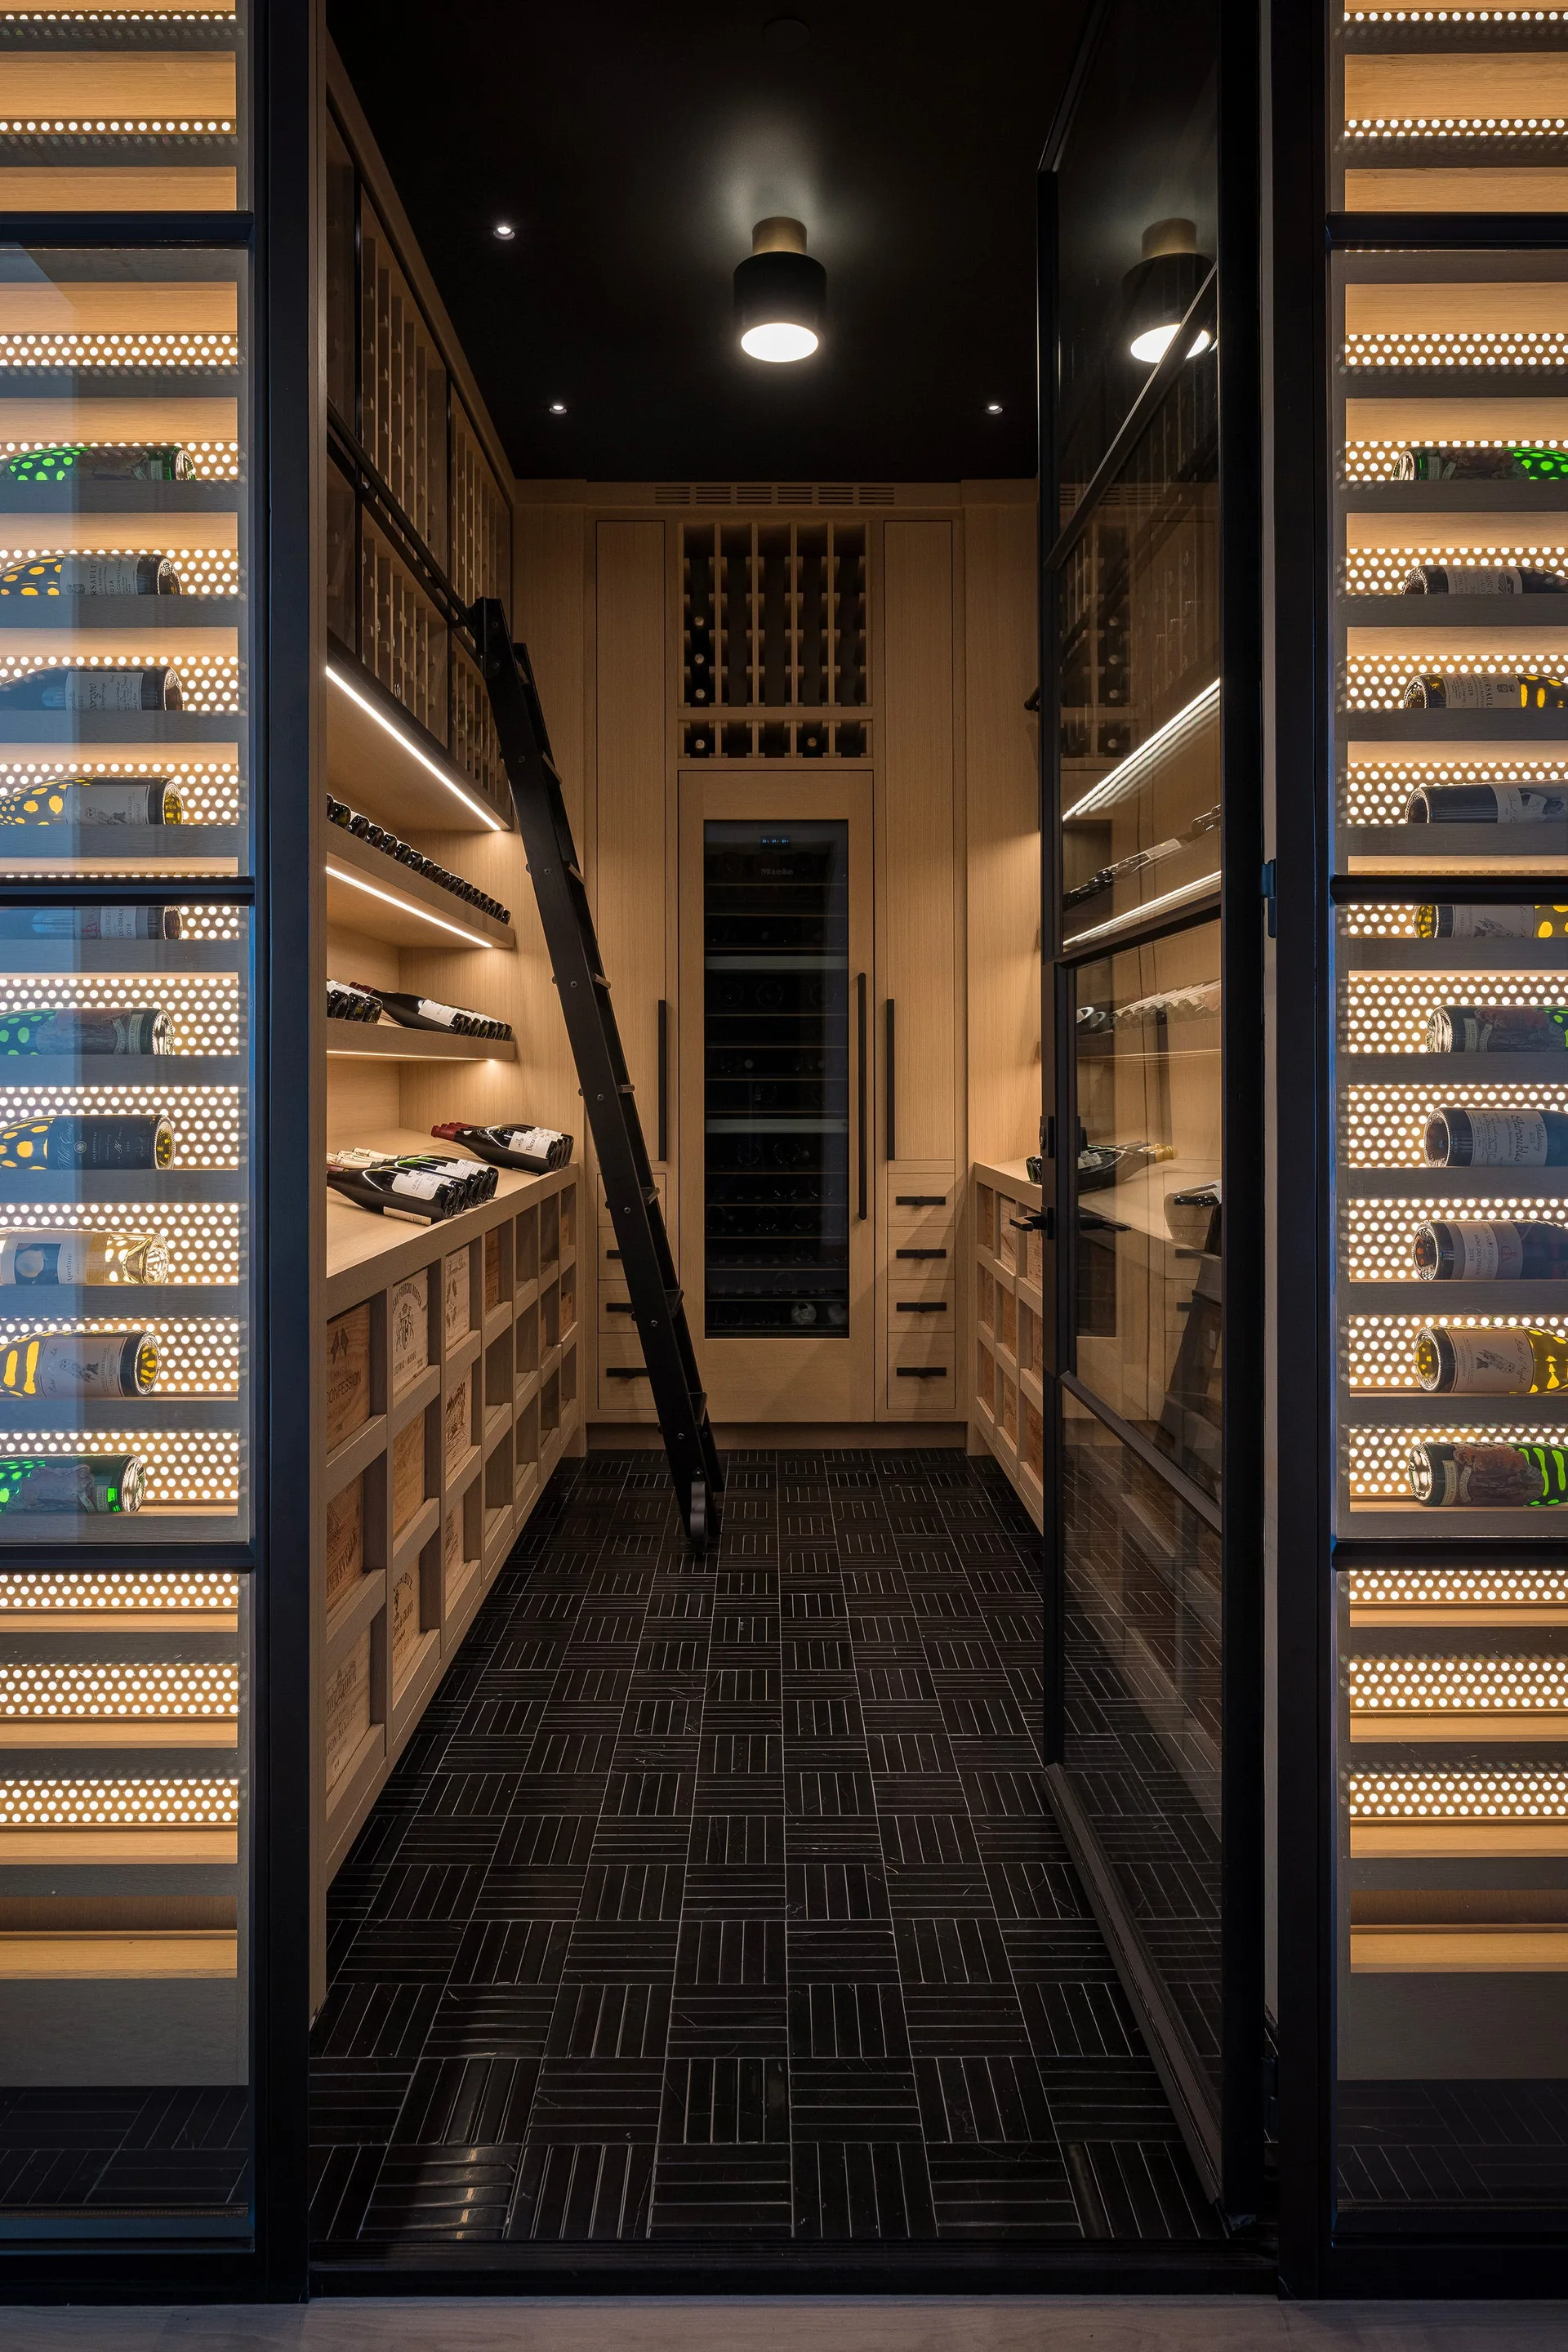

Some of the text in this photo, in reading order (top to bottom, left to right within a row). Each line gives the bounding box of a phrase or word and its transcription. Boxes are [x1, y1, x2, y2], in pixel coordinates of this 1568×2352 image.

[1511, 1115, 1528, 1162] Chiroubles
[57, 1147, 72, 1169] Mill
[1514, 1339, 1526, 1355] Bird
[1516, 1365, 1530, 1384] Night
